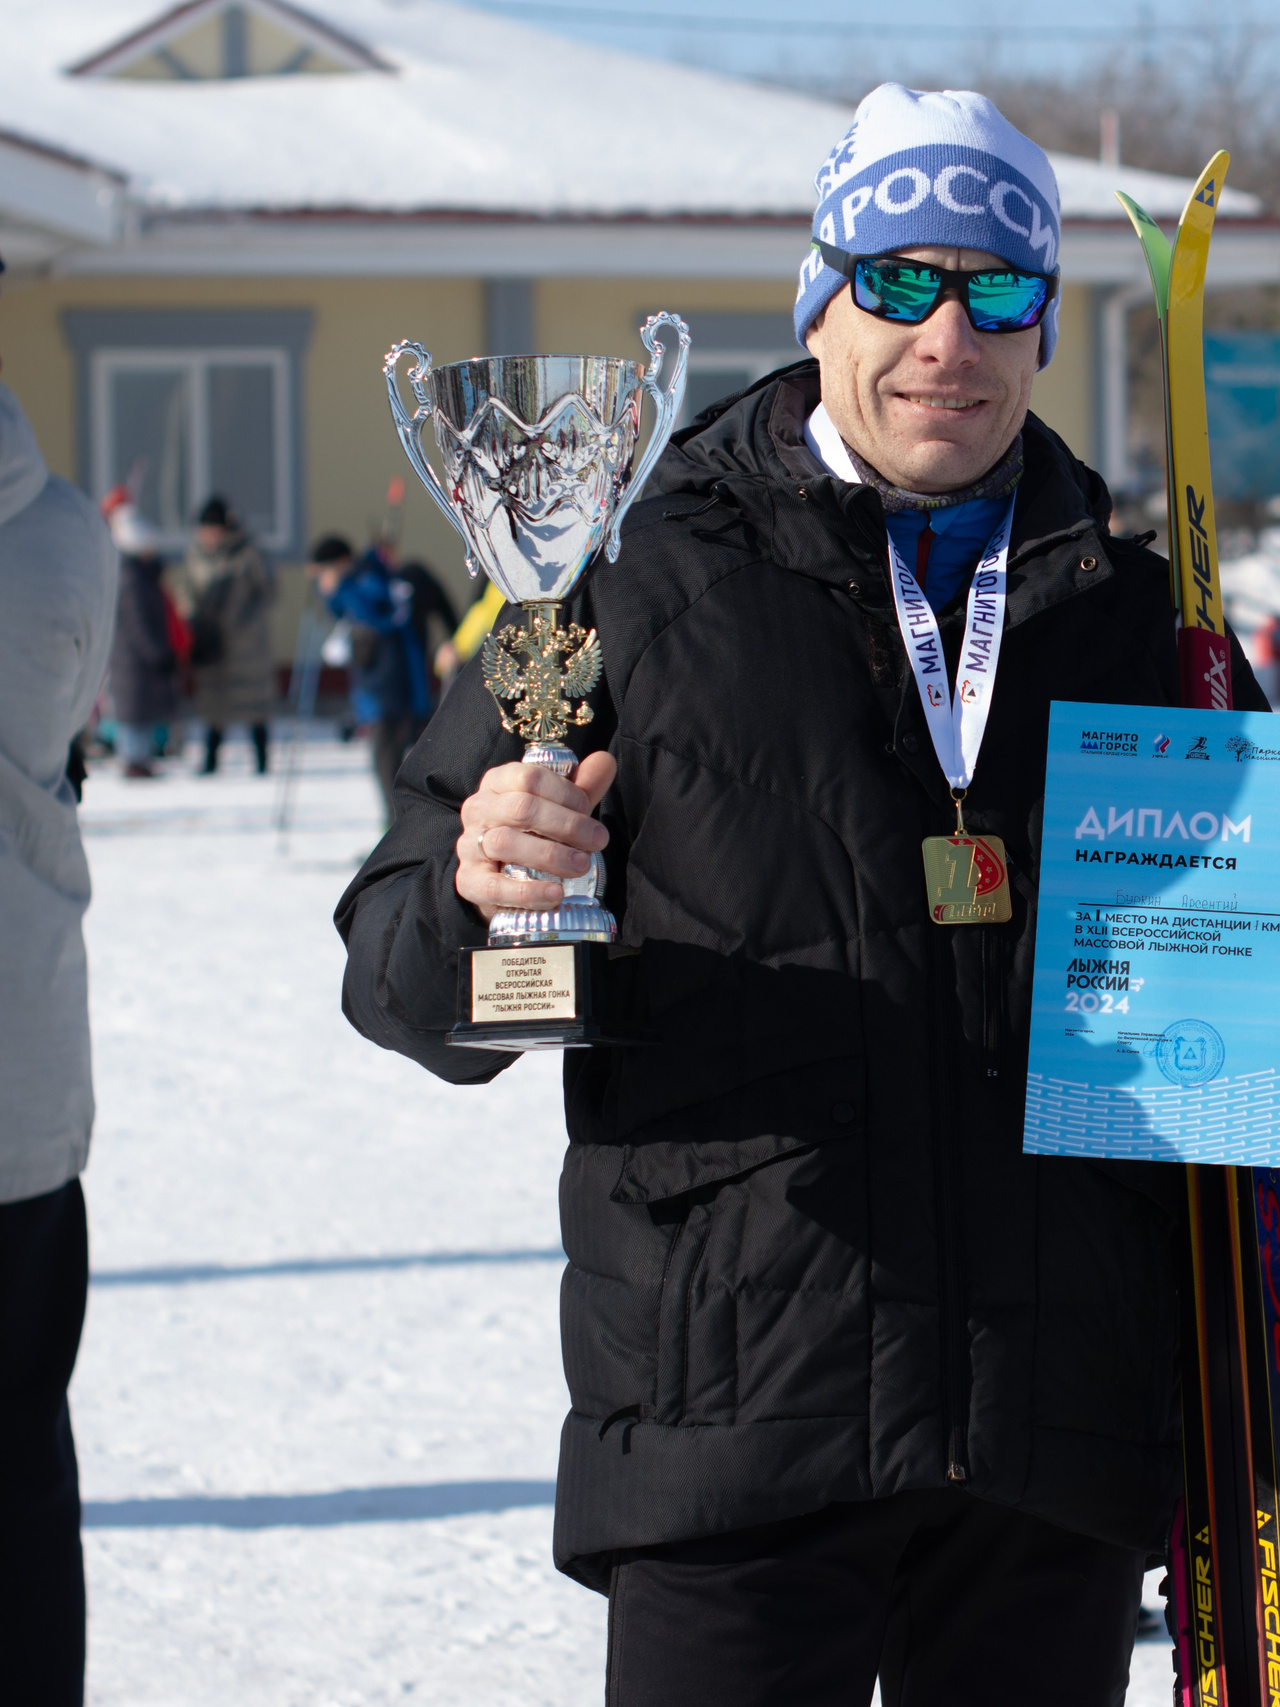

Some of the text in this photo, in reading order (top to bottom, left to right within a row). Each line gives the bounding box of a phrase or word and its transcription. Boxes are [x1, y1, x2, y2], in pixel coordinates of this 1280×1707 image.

[842, 165, 1057, 276] РОССИ
[1081, 731, 1139, 742] МАГНИТО
[1099, 742, 1138, 752] ГОРСК
[1075, 805, 1252, 843] ДИПЛОМ
[1075, 849, 1237, 870] НАГРАЖДАЕТСЯ
[1075, 911, 1092, 921] ЗА
[1105, 913, 1148, 925] МЕСТО
[1151, 915, 1169, 926] НА
[1172, 917, 1251, 932] ДИСТАНЦИИ
[1262, 921, 1280, 932] КМ
[1075, 925, 1083, 934] В
[1112, 926, 1221, 942] ВСЕРОССИЙСКОЙ
[1074, 937, 1253, 957] МАССОВОЙ ЛЫЖНОЙ ГОНКЕ
[501, 956, 547, 967] ПОБЕДИТЕЛЬ
[1066, 958, 1130, 975] ЛЫЖНЯ
[506, 968, 542, 978] ОТКРЫТАЯ
[495, 978, 553, 990] ВСЕРОССИЙСКАЯ
[1067, 974, 1129, 991] РОССИИ
[478, 989, 570, 1001] МАССОВАЯ ЛЫЖНАЯ ГОНКА
[1064, 992, 1130, 1014] 2024
